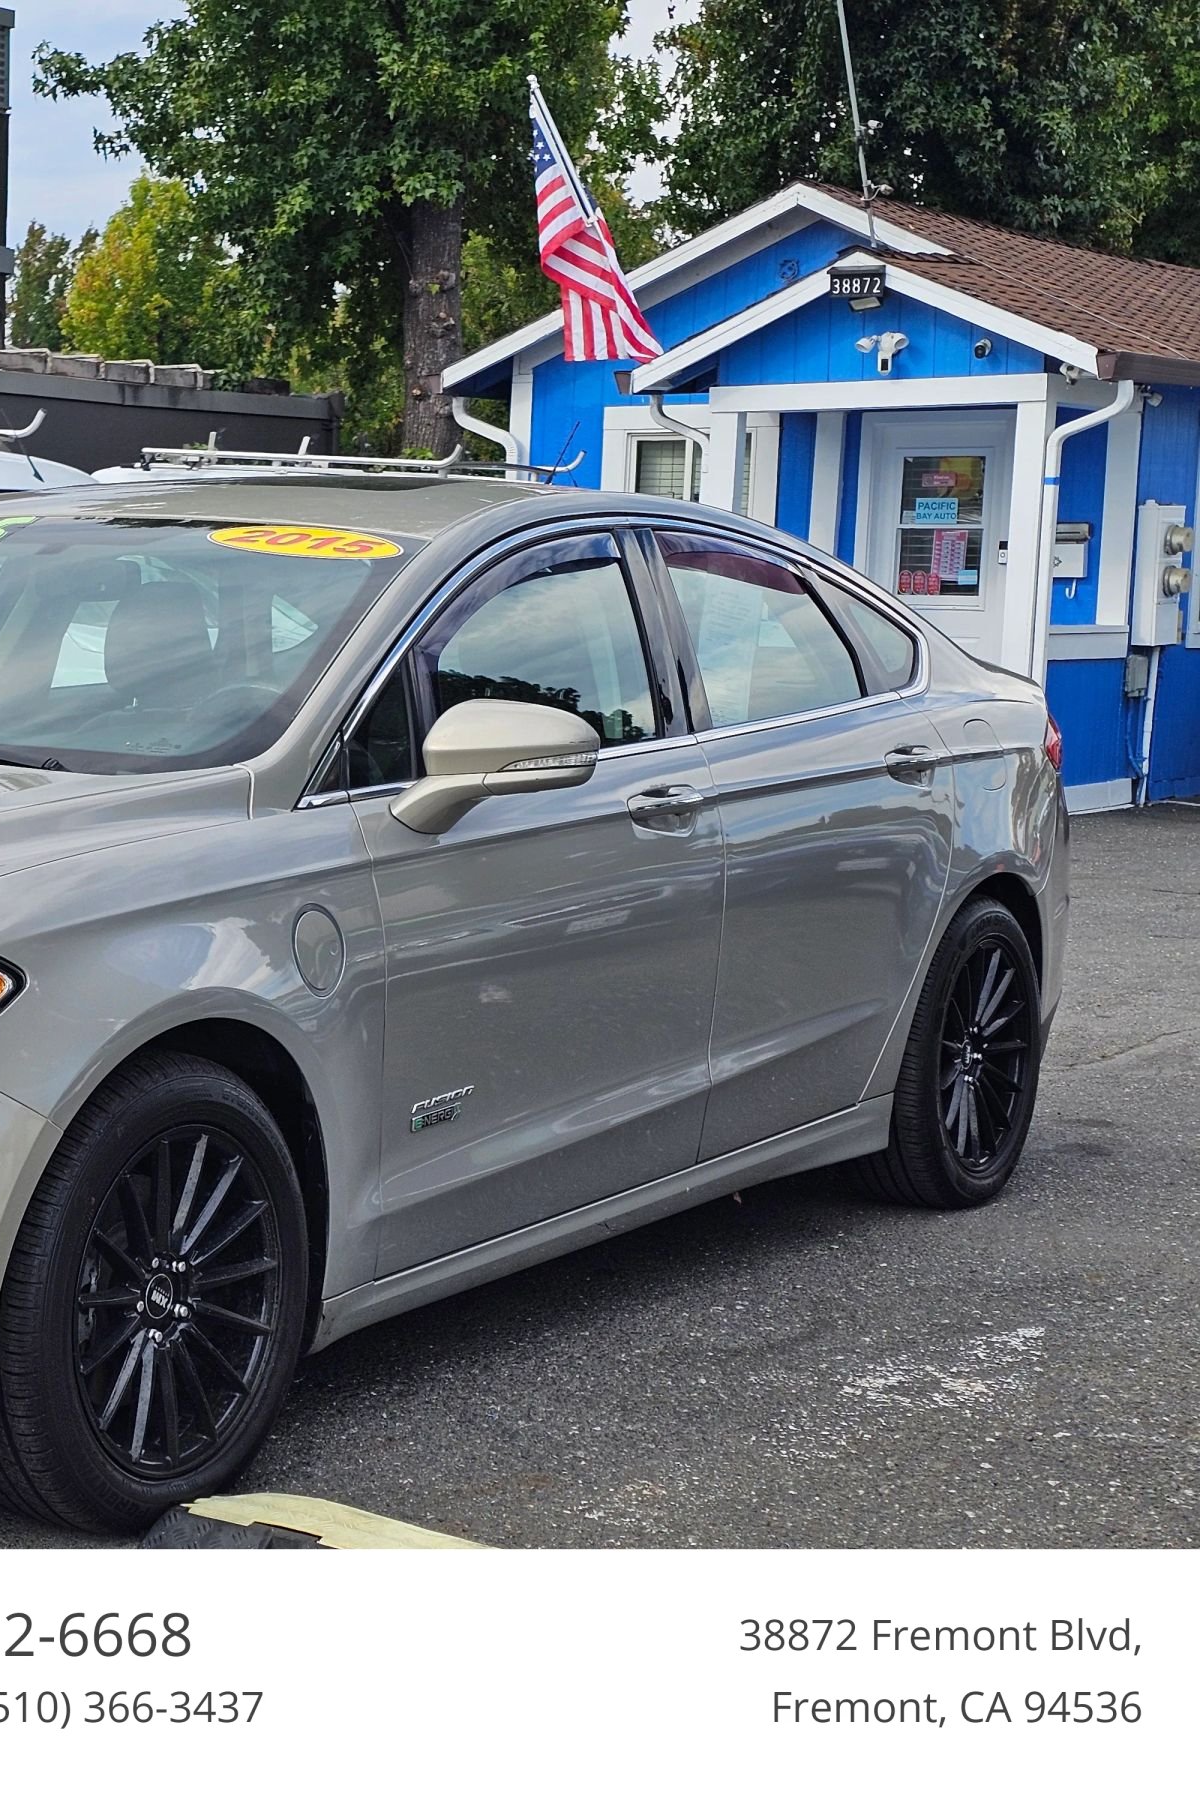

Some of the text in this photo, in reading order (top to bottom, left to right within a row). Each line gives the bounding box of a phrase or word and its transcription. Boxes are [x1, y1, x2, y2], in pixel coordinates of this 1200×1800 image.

[832, 277, 881, 294] 38872
[917, 501, 956, 511] PACIFIC
[916, 512, 957, 520] BAY AUTO
[223, 530, 386, 554] 2015
